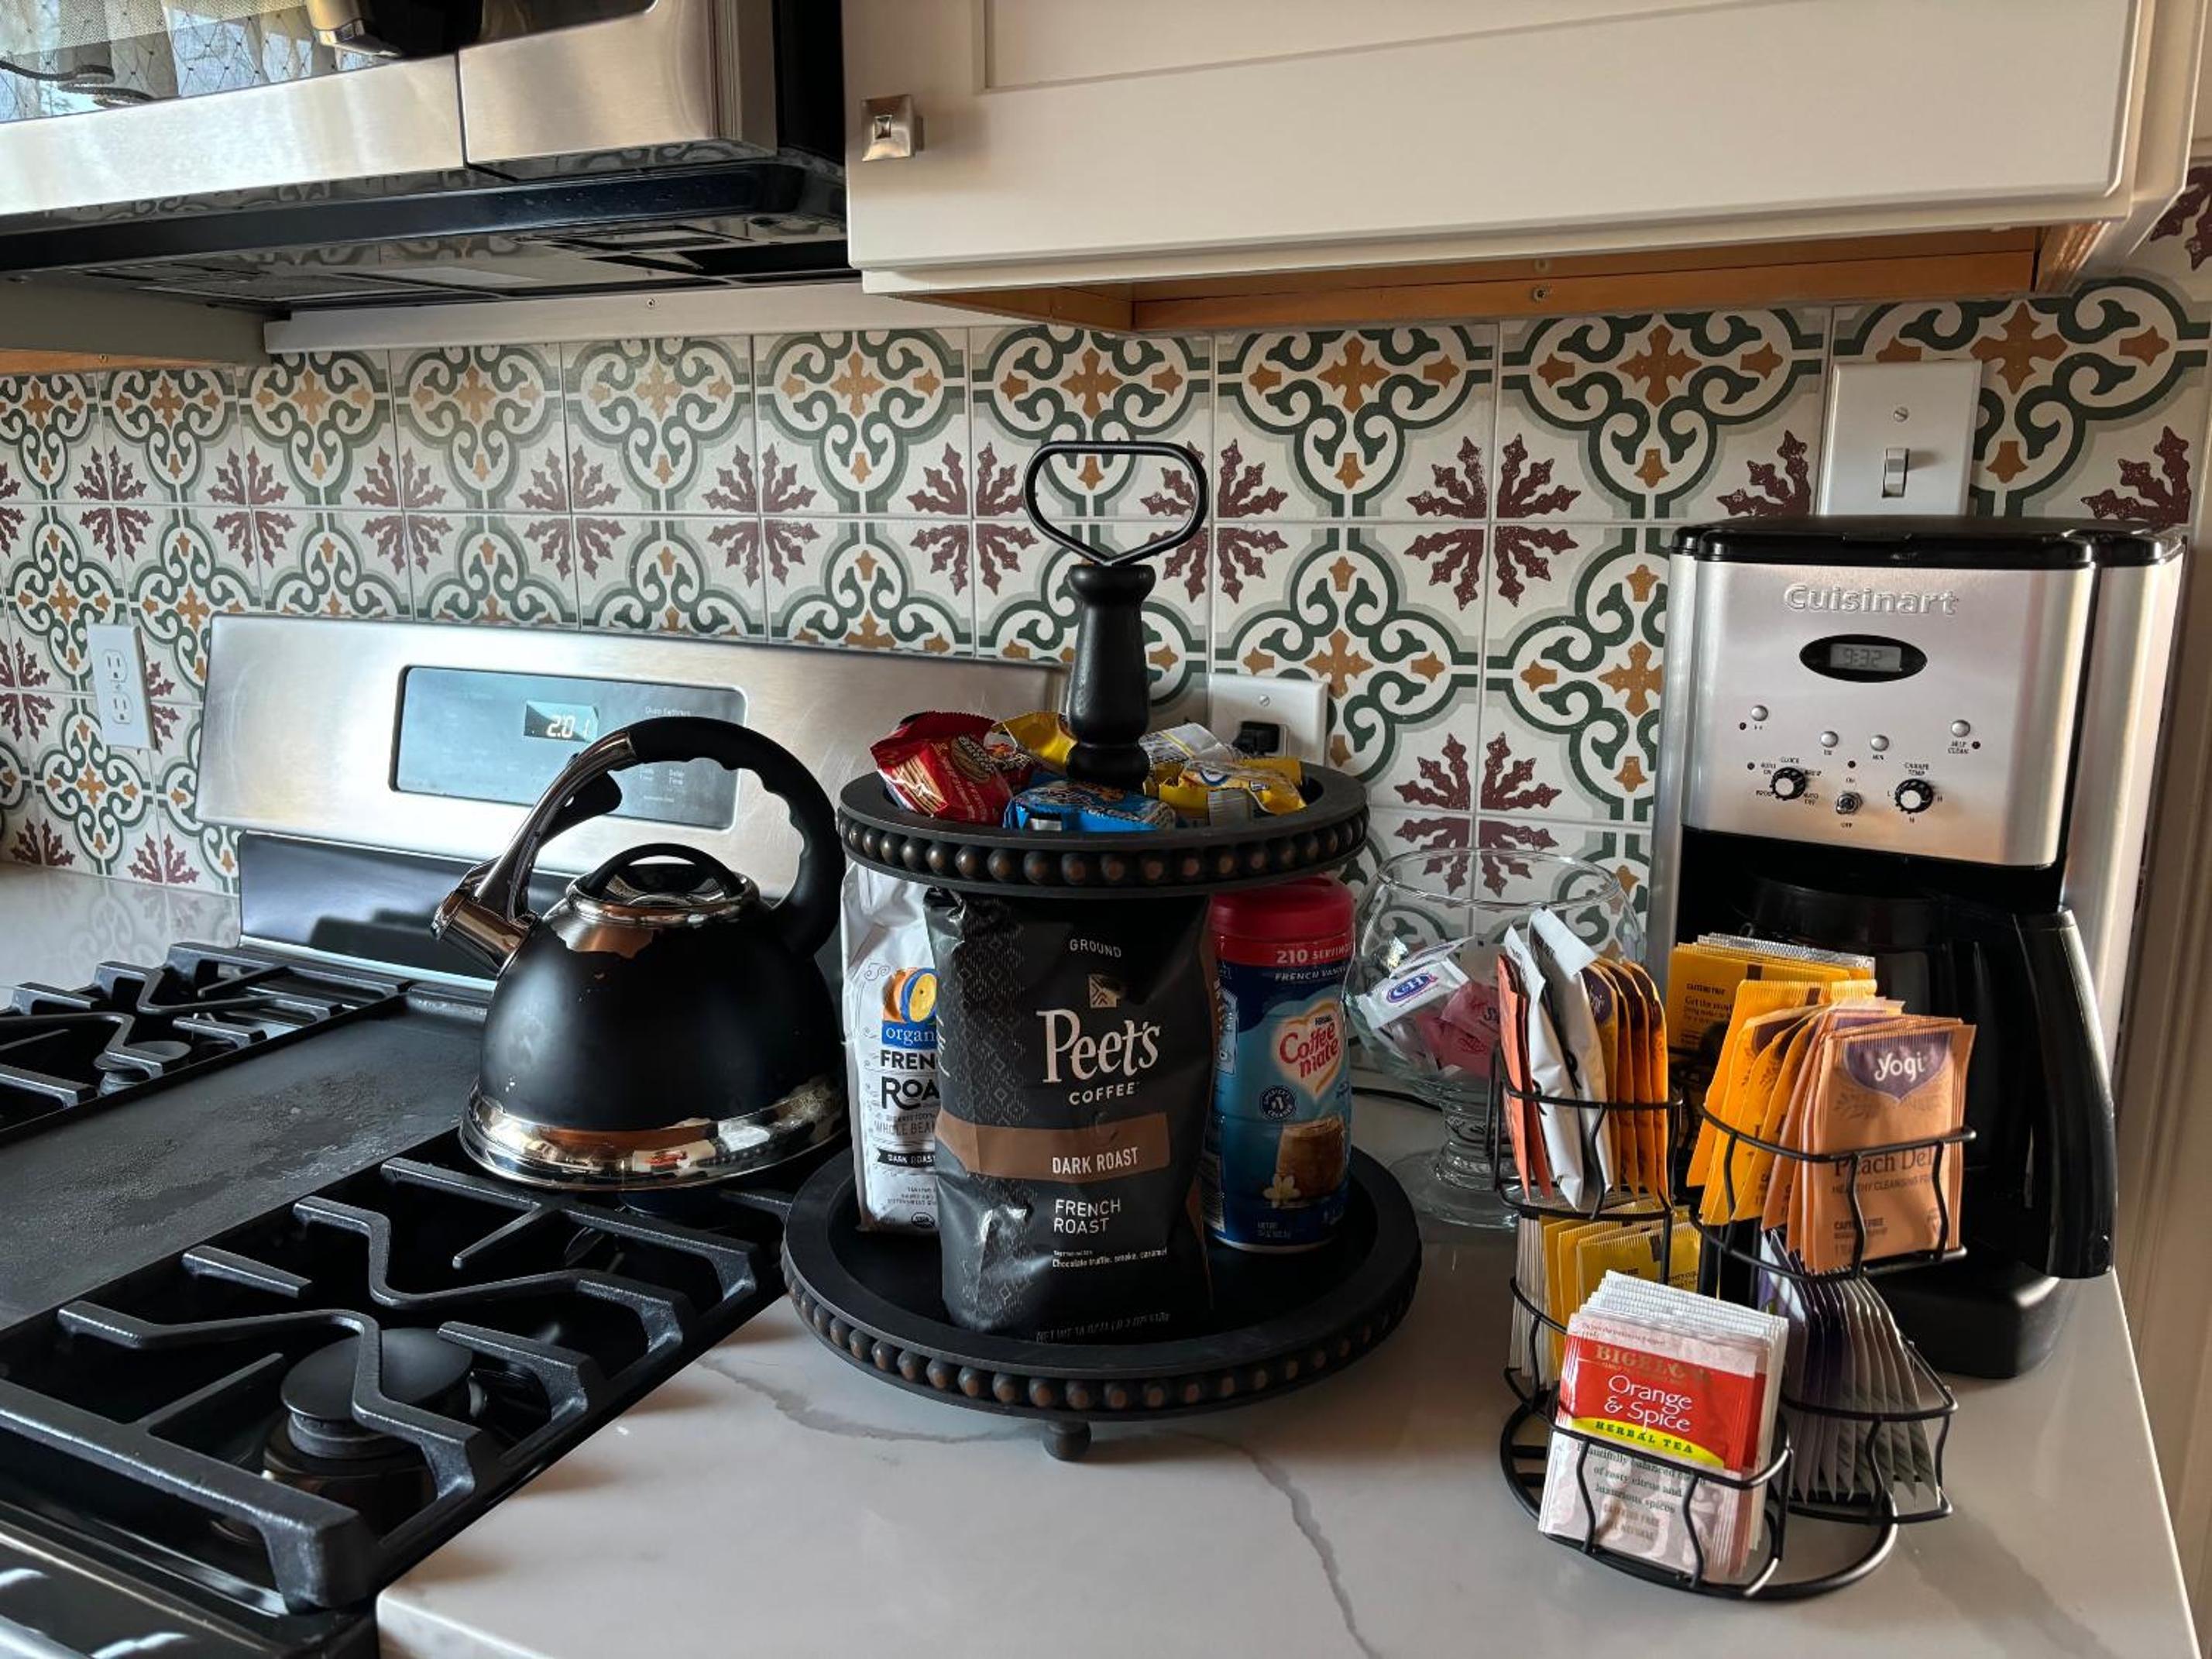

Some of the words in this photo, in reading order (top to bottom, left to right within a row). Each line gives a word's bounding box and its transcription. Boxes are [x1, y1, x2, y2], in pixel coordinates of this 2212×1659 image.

[1784, 583, 1956, 615] Cuisinart
[1070, 939, 1122, 958] GROUND
[1276, 950, 1309, 964] 210
[1275, 971, 1320, 982] FRENCH
[885, 1027, 936, 1046] organ
[1036, 1008, 1161, 1083] Peet's
[1279, 1022, 1336, 1063] Coffee
[881, 1049, 936, 1070] FREN
[1300, 1038, 1338, 1079] mate
[1874, 1052, 1925, 1082] yogi
[881, 1076, 940, 1111] ROA
[1068, 1081, 1135, 1105] COFFEE
[1052, 1156, 1092, 1175] DARK
[1097, 1146, 1139, 1172] ROAST
[1834, 1149, 1895, 1176] Pach
[1055, 1198, 1121, 1218] FRENCH
[1053, 1218, 1110, 1234] ROAST
[1608, 1375, 1693, 1415] Orange
[1604, 1395, 1623, 1413] &
[1627, 1401, 1692, 1433] Spice
[1595, 1420, 1657, 1444] HERBAL
[1663, 1439, 1694, 1454] TEA
